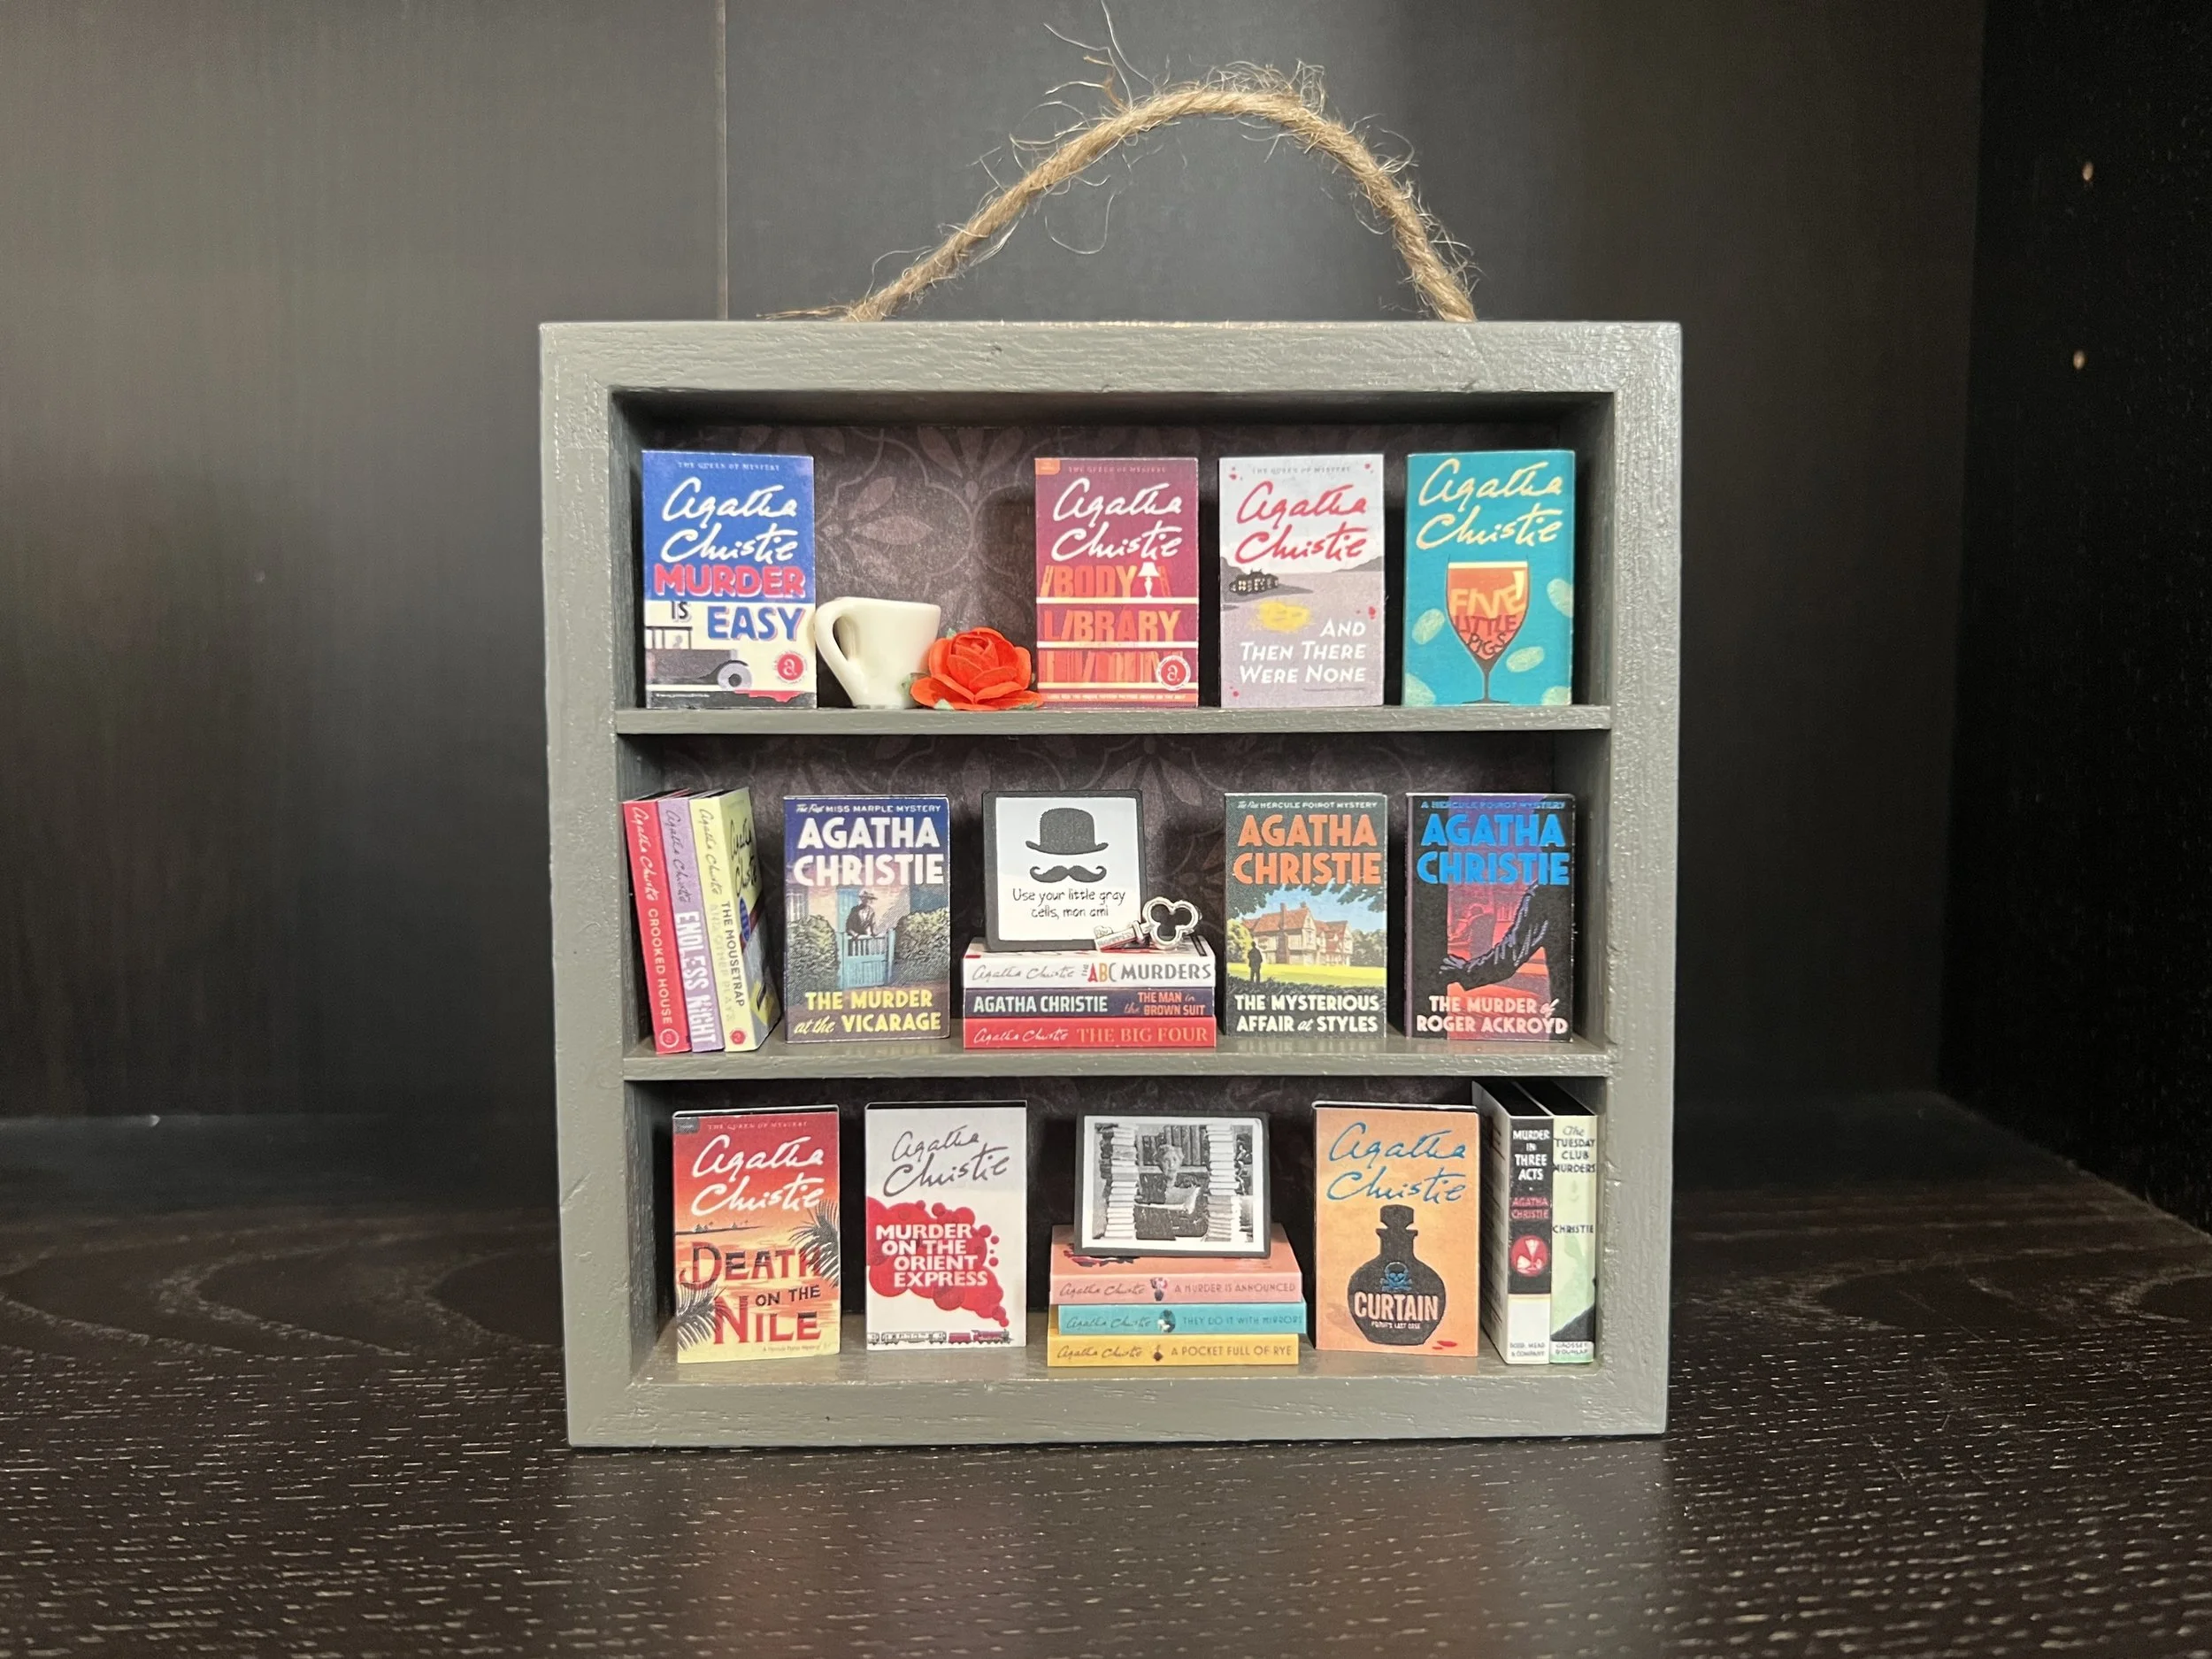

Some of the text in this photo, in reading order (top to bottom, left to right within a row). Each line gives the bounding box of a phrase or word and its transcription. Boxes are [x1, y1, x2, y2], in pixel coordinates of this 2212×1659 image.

[1417, 457, 1563, 513] Agatha
[662, 476, 798, 529] Agatha
[1052, 477, 1183, 528] Agatha
[1235, 480, 1368, 530] Agatha
[1416, 503, 1563, 550] Christie
[660, 523, 799, 565] Christie
[1050, 520, 1183, 562] Christie
[1234, 521, 1369, 565] Christie
[653, 562, 806, 599] MURDER
[1053, 565, 1138, 598] BODY
[671, 601, 692, 623] IS
[1450, 583, 1526, 619] FIVE
[707, 605, 806, 642] EASY
[1044, 608, 1182, 642] LIBRARY
[1319, 618, 1366, 638] AND
[1455, 614, 1517, 636] LITTLE
[1240, 639, 1367, 662] THEN THERE
[1468, 630, 1507, 656] PIGS
[1239, 664, 1366, 684] WERE NONE
[826, 804, 850, 813] MISS
[852, 804, 894, 813] MARPLE
[895, 803, 941, 813] MYSTERY
[797, 816, 941, 850] AGATHA
[1237, 814, 1378, 848] AGATHA
[1420, 813, 1566, 848] AGATHA
[793, 853, 944, 887] CHRISTIE
[1233, 852, 1382, 886] CHRISTIE
[1417, 851, 1571, 886] CHRISTIE
[1012, 887, 1126, 907] Use your little gray
[632, 806, 651, 853] Agatha
[648, 908, 666, 974] CROOKED
[657, 978, 672, 1025] HOUSE
[721, 900, 733, 926] THE
[1031, 904, 1109, 920] cells, mon ami
[675, 910, 710, 991] ENDLESS
[726, 930, 745, 1007] MOUSETRAP
[972, 964, 1075, 982] Agatha Christie
[1087, 962, 1118, 983] ABC
[1120, 964, 1211, 981] MURDERS
[805, 989, 933, 1010] THE MURDER
[973, 995, 1109, 1013] AGATHA CHRISTIE
[1137, 991, 1157, 1002] THE
[1158, 991, 1182, 1002] MAN
[1234, 994, 1380, 1012] THE MYSTERIOUS
[1428, 995, 1559, 1018] THE MURDER of
[1143, 1004, 1181, 1016] BROWN
[1182, 1004, 1206, 1016] SUIT
[794, 1011, 941, 1034] at the VICARAGE
[1236, 1014, 1379, 1033] AFFAIR at STYLES
[1416, 1014, 1569, 1034] ROGER ACKROYD
[973, 1026, 1069, 1044] Agatha Christie
[1076, 1026, 1209, 1043] THE BIG FOUR
[1512, 1129, 1551, 1141] MURDER
[1562, 1125, 1586, 1137] The
[891, 1125, 979, 1163] Agatha
[1329, 1121, 1466, 1169] Agatha
[1525, 1142, 1537, 1152] IN
[1555, 1139, 1595, 1148] TUESDAY
[692, 1133, 824, 1183] Agatha
[1514, 1153, 1548, 1167] THREE
[1561, 1150, 1590, 1160] CLUB
[883, 1142, 1010, 1197] Christie
[1517, 1168, 1545, 1181] ACTS
[690, 1171, 825, 1217] Christie
[1326, 1165, 1467, 1204] Christie
[1511, 1196, 1549, 1207] AGATHA
[1511, 1209, 1550, 1220] CHRISTIE
[875, 1223, 973, 1240] MURDER
[1553, 1224, 1594, 1234] CHRISTIE
[881, 1239, 967, 1256] ON THE
[679, 1240, 823, 1291] DEATH
[893, 1255, 979, 1271] ORIENT
[894, 1271, 988, 1288] EXPRESS
[1059, 1282, 1101, 1297] Agatha
[1173, 1282, 1296, 1294] A MURDER IS ANNOUNCED
[755, 1285, 820, 1308] ON THE
[1354, 1291, 1439, 1322] CURTAIN
[713, 1294, 822, 1345] NILE
[1182, 1316, 1204, 1325] THEY
[1208, 1316, 1224, 1325] DO
[1225, 1316, 1234, 1325] IT
[1236, 1315, 1259, 1325] WITH
[1056, 1345, 1099, 1359] Agatha
[1171, 1345, 1292, 1357] A POCKET FULL OF RYE
